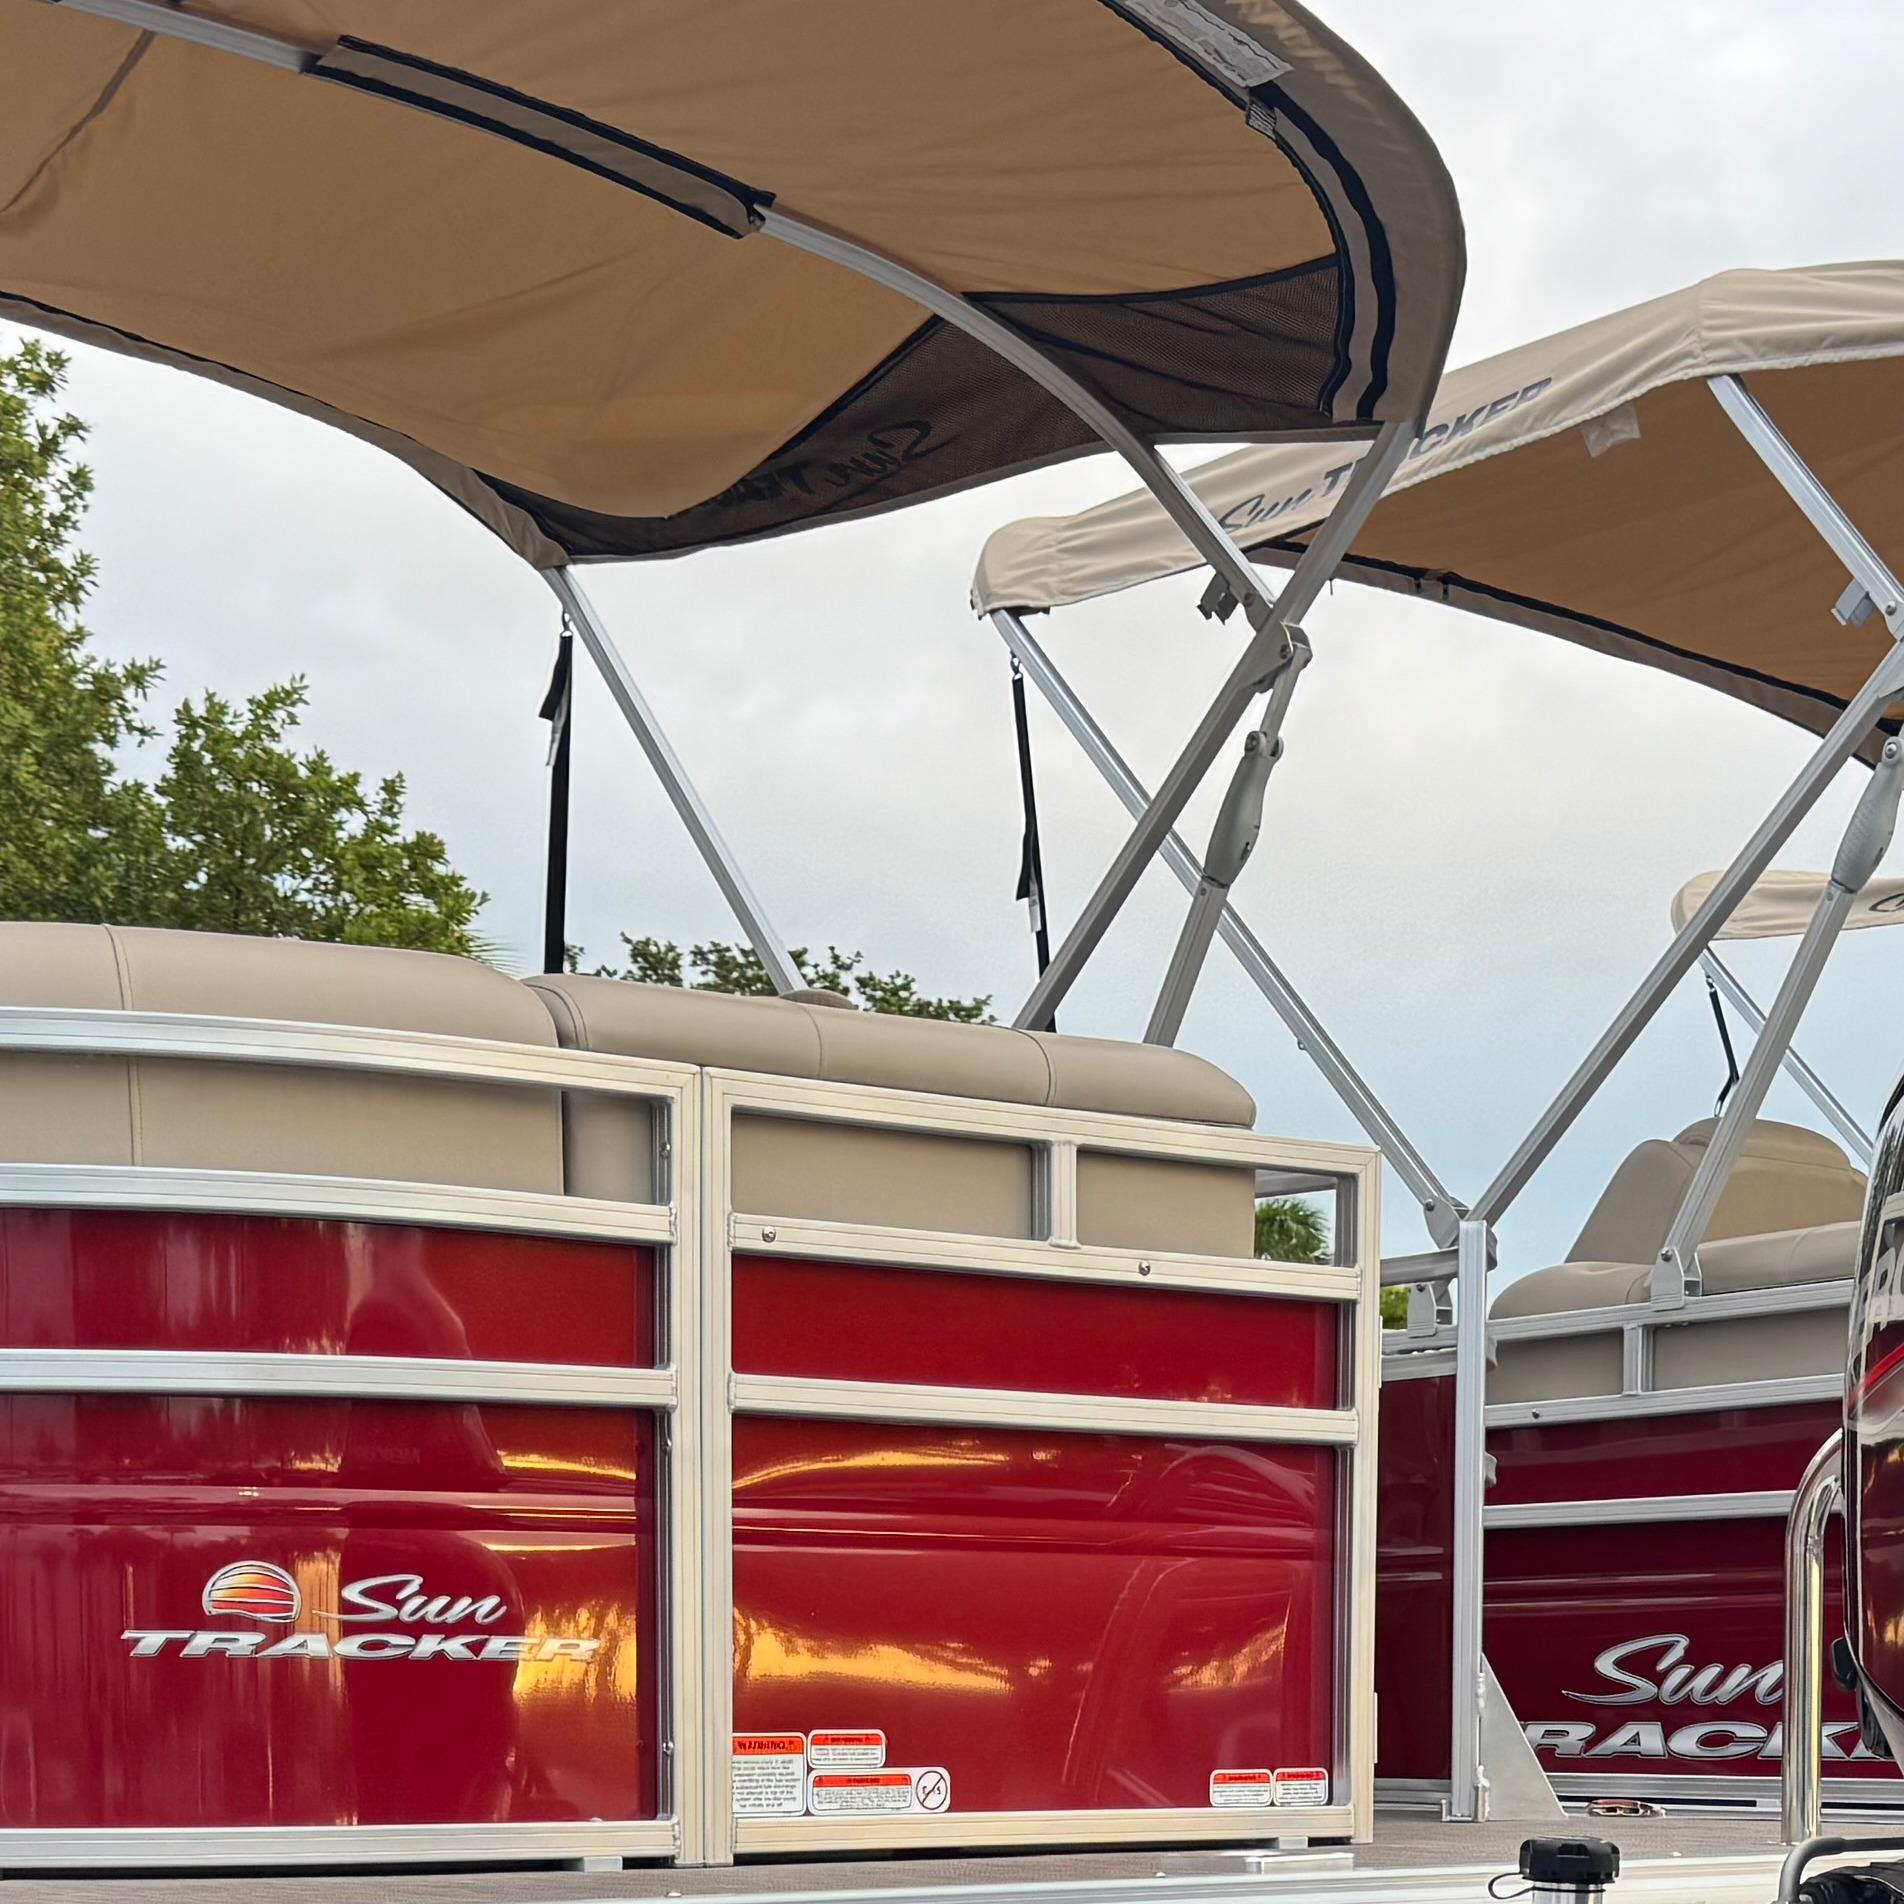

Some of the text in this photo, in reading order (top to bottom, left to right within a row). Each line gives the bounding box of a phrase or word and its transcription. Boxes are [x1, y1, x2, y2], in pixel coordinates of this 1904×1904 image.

[1322, 377, 1553, 498] TCKER
[311, 1574, 508, 1624] Sun
[120, 1629, 601, 1662] TRACKER
[1560, 1633, 1785, 1706] Sun
